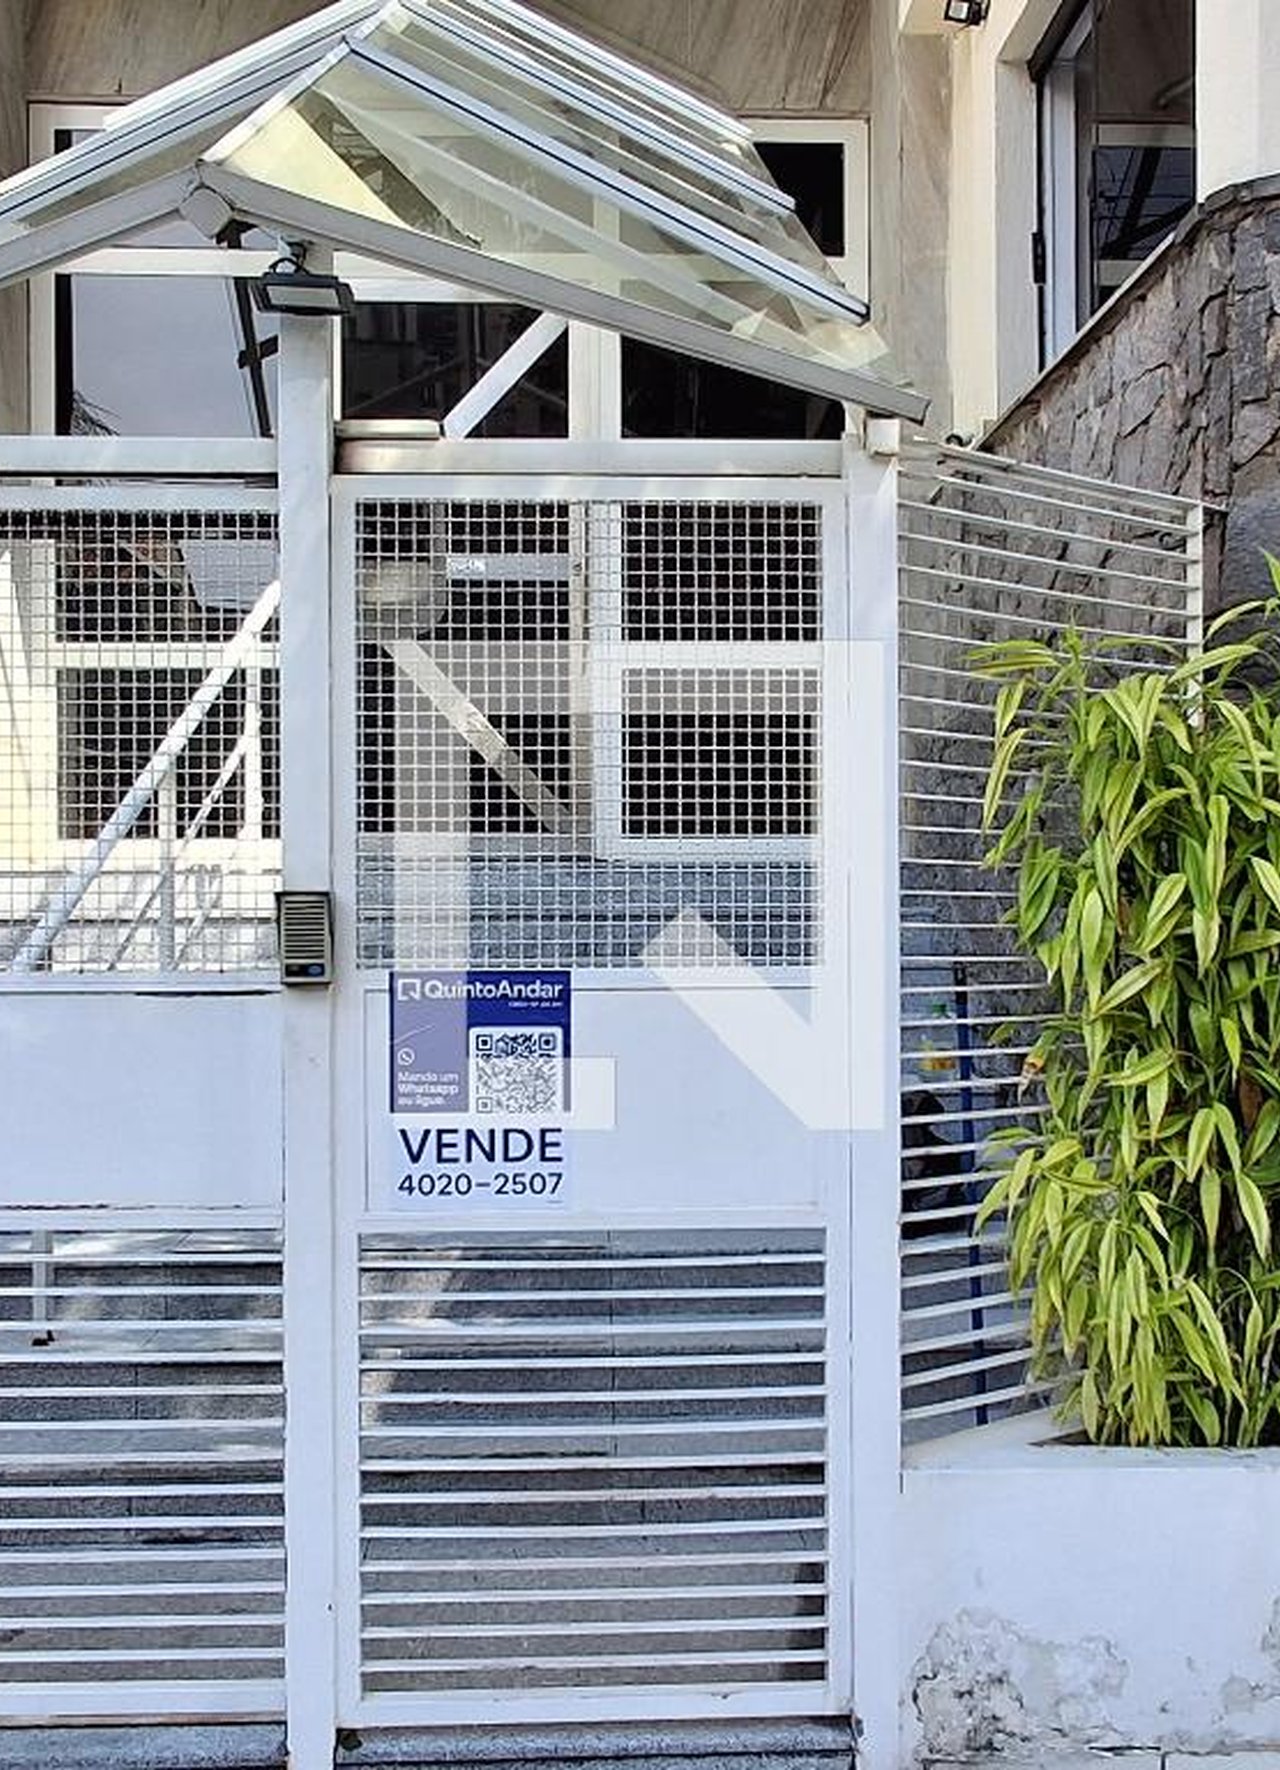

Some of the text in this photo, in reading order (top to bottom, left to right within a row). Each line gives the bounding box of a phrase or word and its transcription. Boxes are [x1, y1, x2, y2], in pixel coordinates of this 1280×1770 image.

[424, 979, 563, 999] QuintoAndar
[440, 1073, 459, 1083] um
[399, 1128, 563, 1164] VENDE
[398, 1173, 563, 1195] 4020-2507
